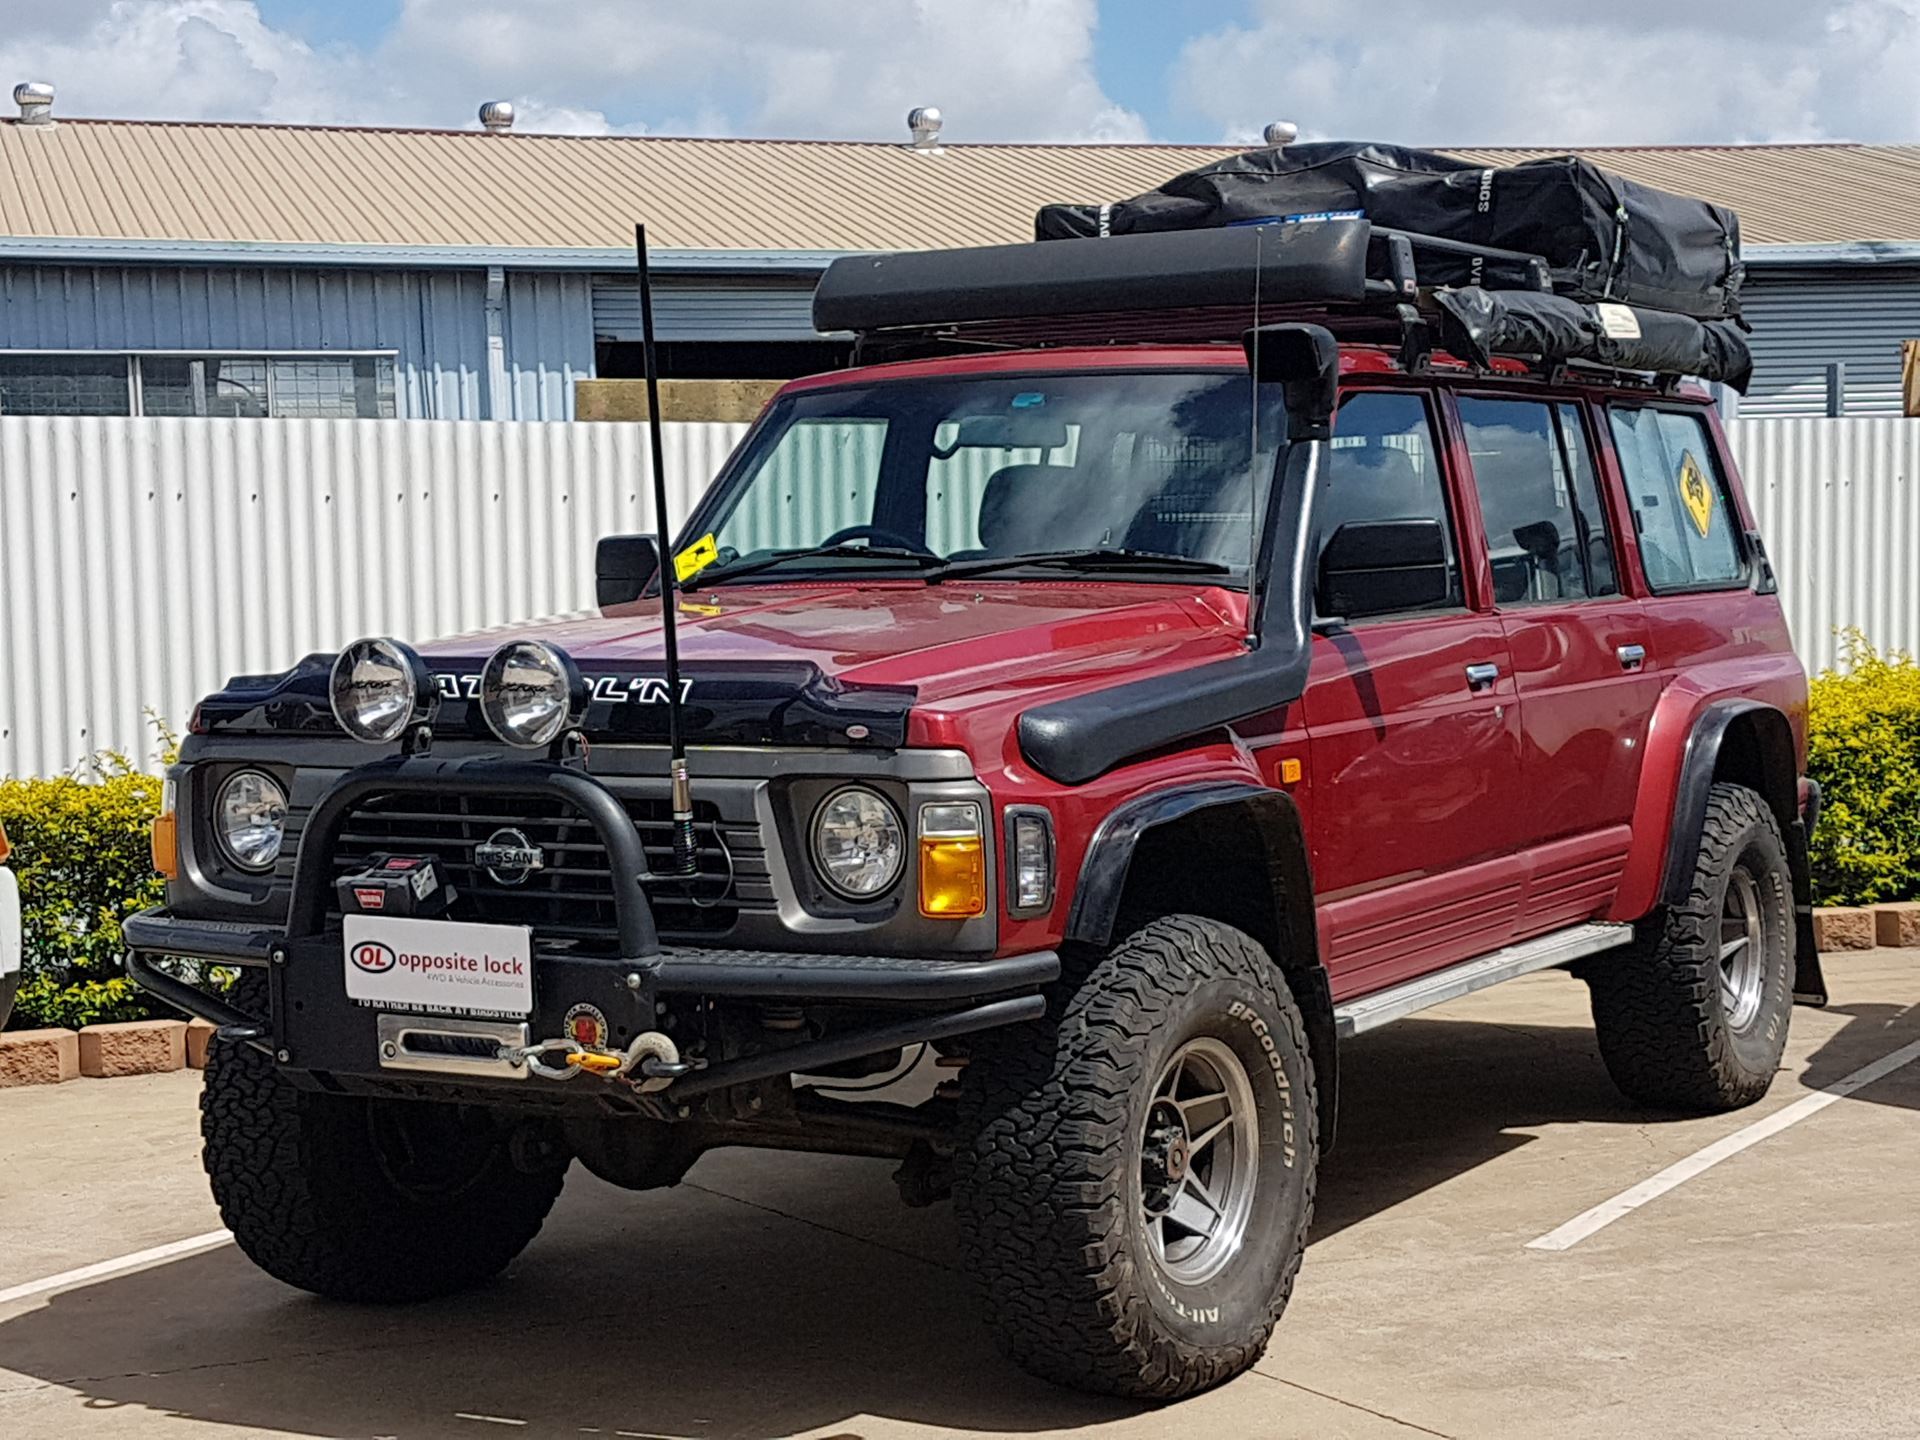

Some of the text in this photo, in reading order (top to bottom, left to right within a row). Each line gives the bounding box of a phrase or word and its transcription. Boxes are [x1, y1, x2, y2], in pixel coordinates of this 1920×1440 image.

[359, 946, 523, 976] OL opposite lock
[1228, 1001, 1296, 1169] BFGoodrich
